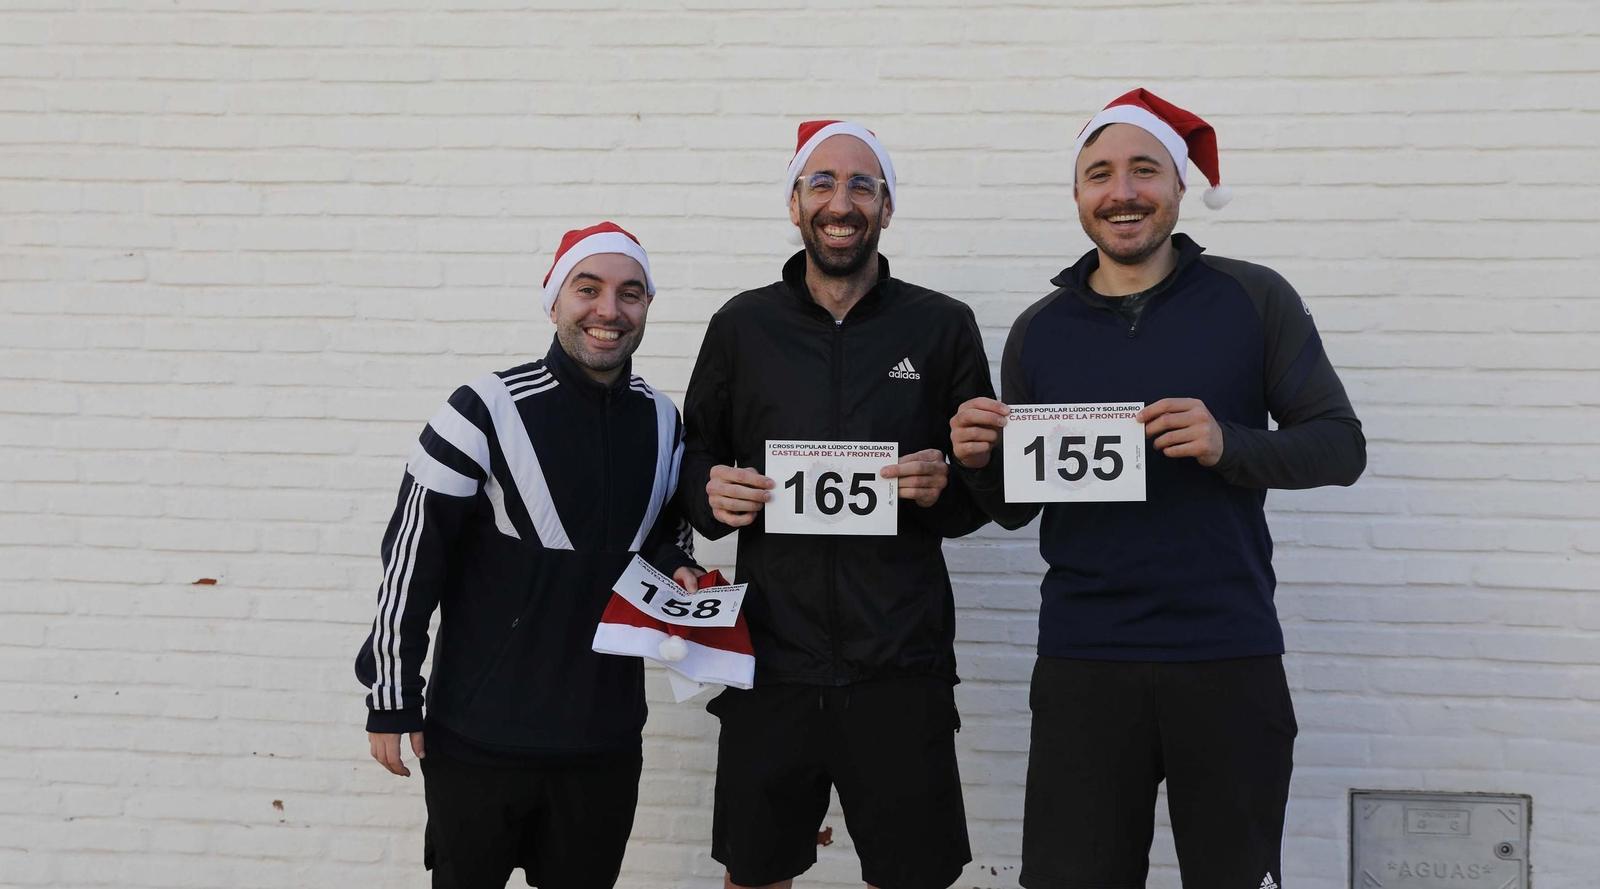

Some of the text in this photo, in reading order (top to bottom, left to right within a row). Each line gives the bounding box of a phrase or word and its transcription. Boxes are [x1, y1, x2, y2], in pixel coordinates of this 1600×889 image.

[888, 370, 921, 380] adidas
[1009, 413, 1060, 421] CASTELLAR
[1090, 412, 1137, 420] FRONTERA
[1069, 405, 1095, 413] LÚDICO
[827, 443, 853, 451] LÚDICO
[1024, 435, 1124, 482] 155
[785, 470, 878, 516] 165
[638, 561, 676, 590] CASTELLAR
[640, 580, 722, 619] 158
